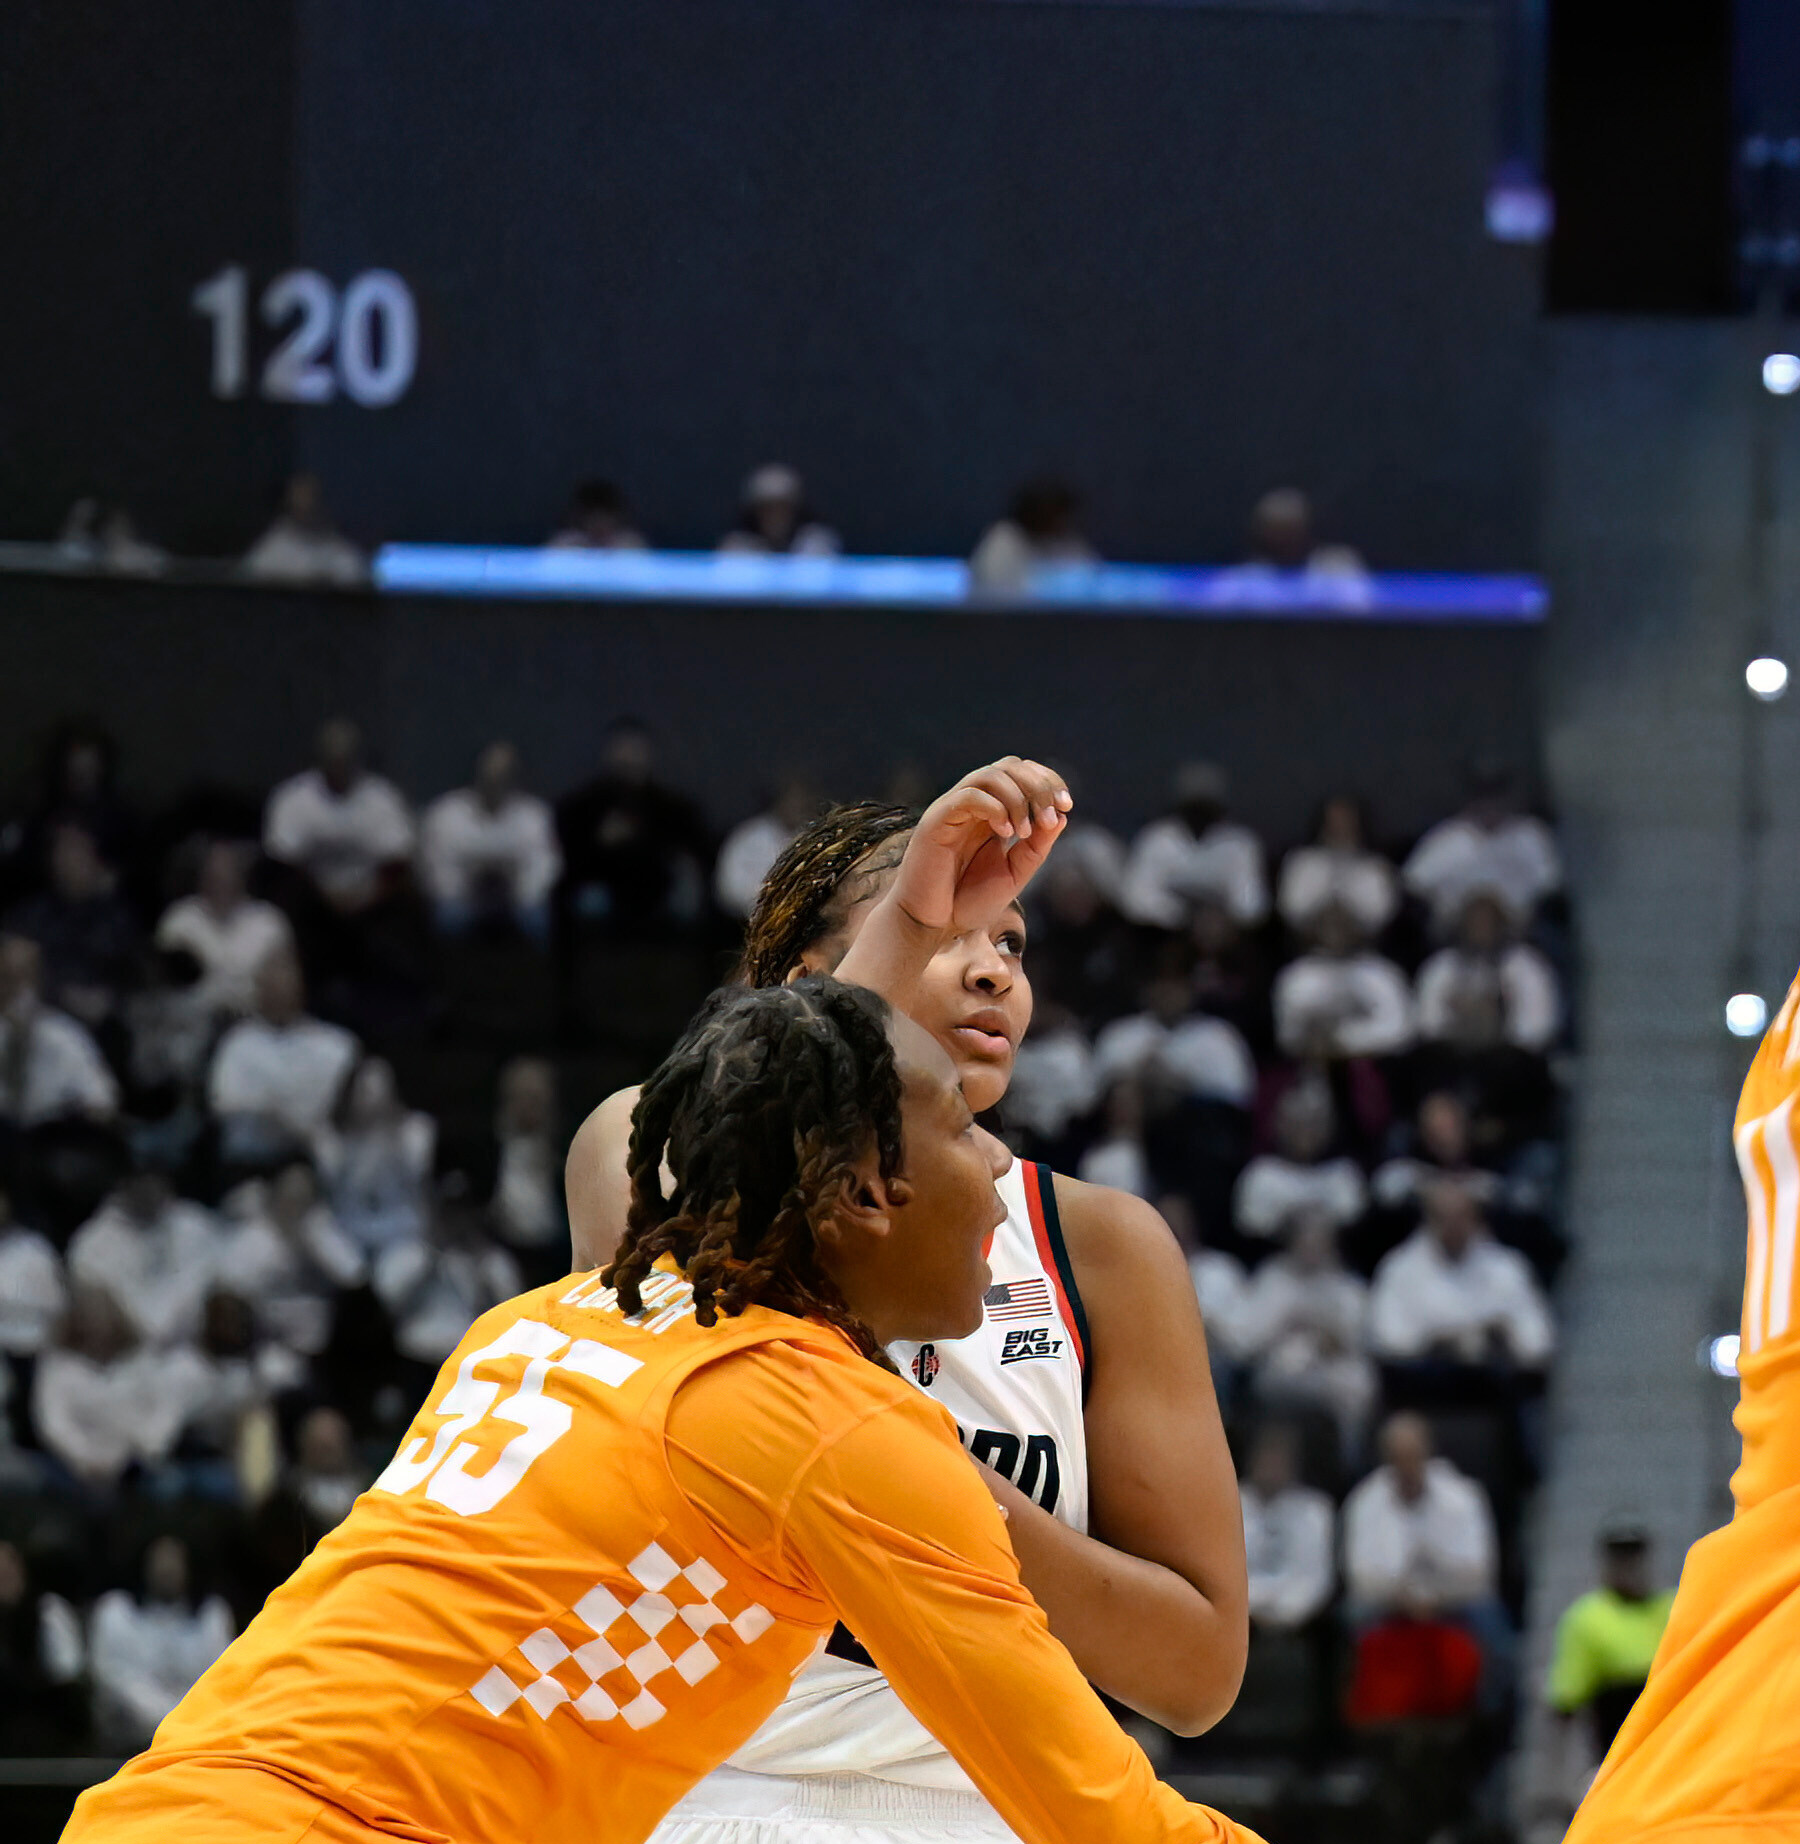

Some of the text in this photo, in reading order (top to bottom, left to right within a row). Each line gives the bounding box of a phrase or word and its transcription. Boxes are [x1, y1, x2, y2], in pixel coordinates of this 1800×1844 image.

[192, 263, 418, 409] 120
[1736, 1099, 1800, 1354] 11
[1001, 1341, 1063, 1359] EAST
[1004, 1328, 1049, 1345] BIG
[373, 1318, 645, 1517] 55
